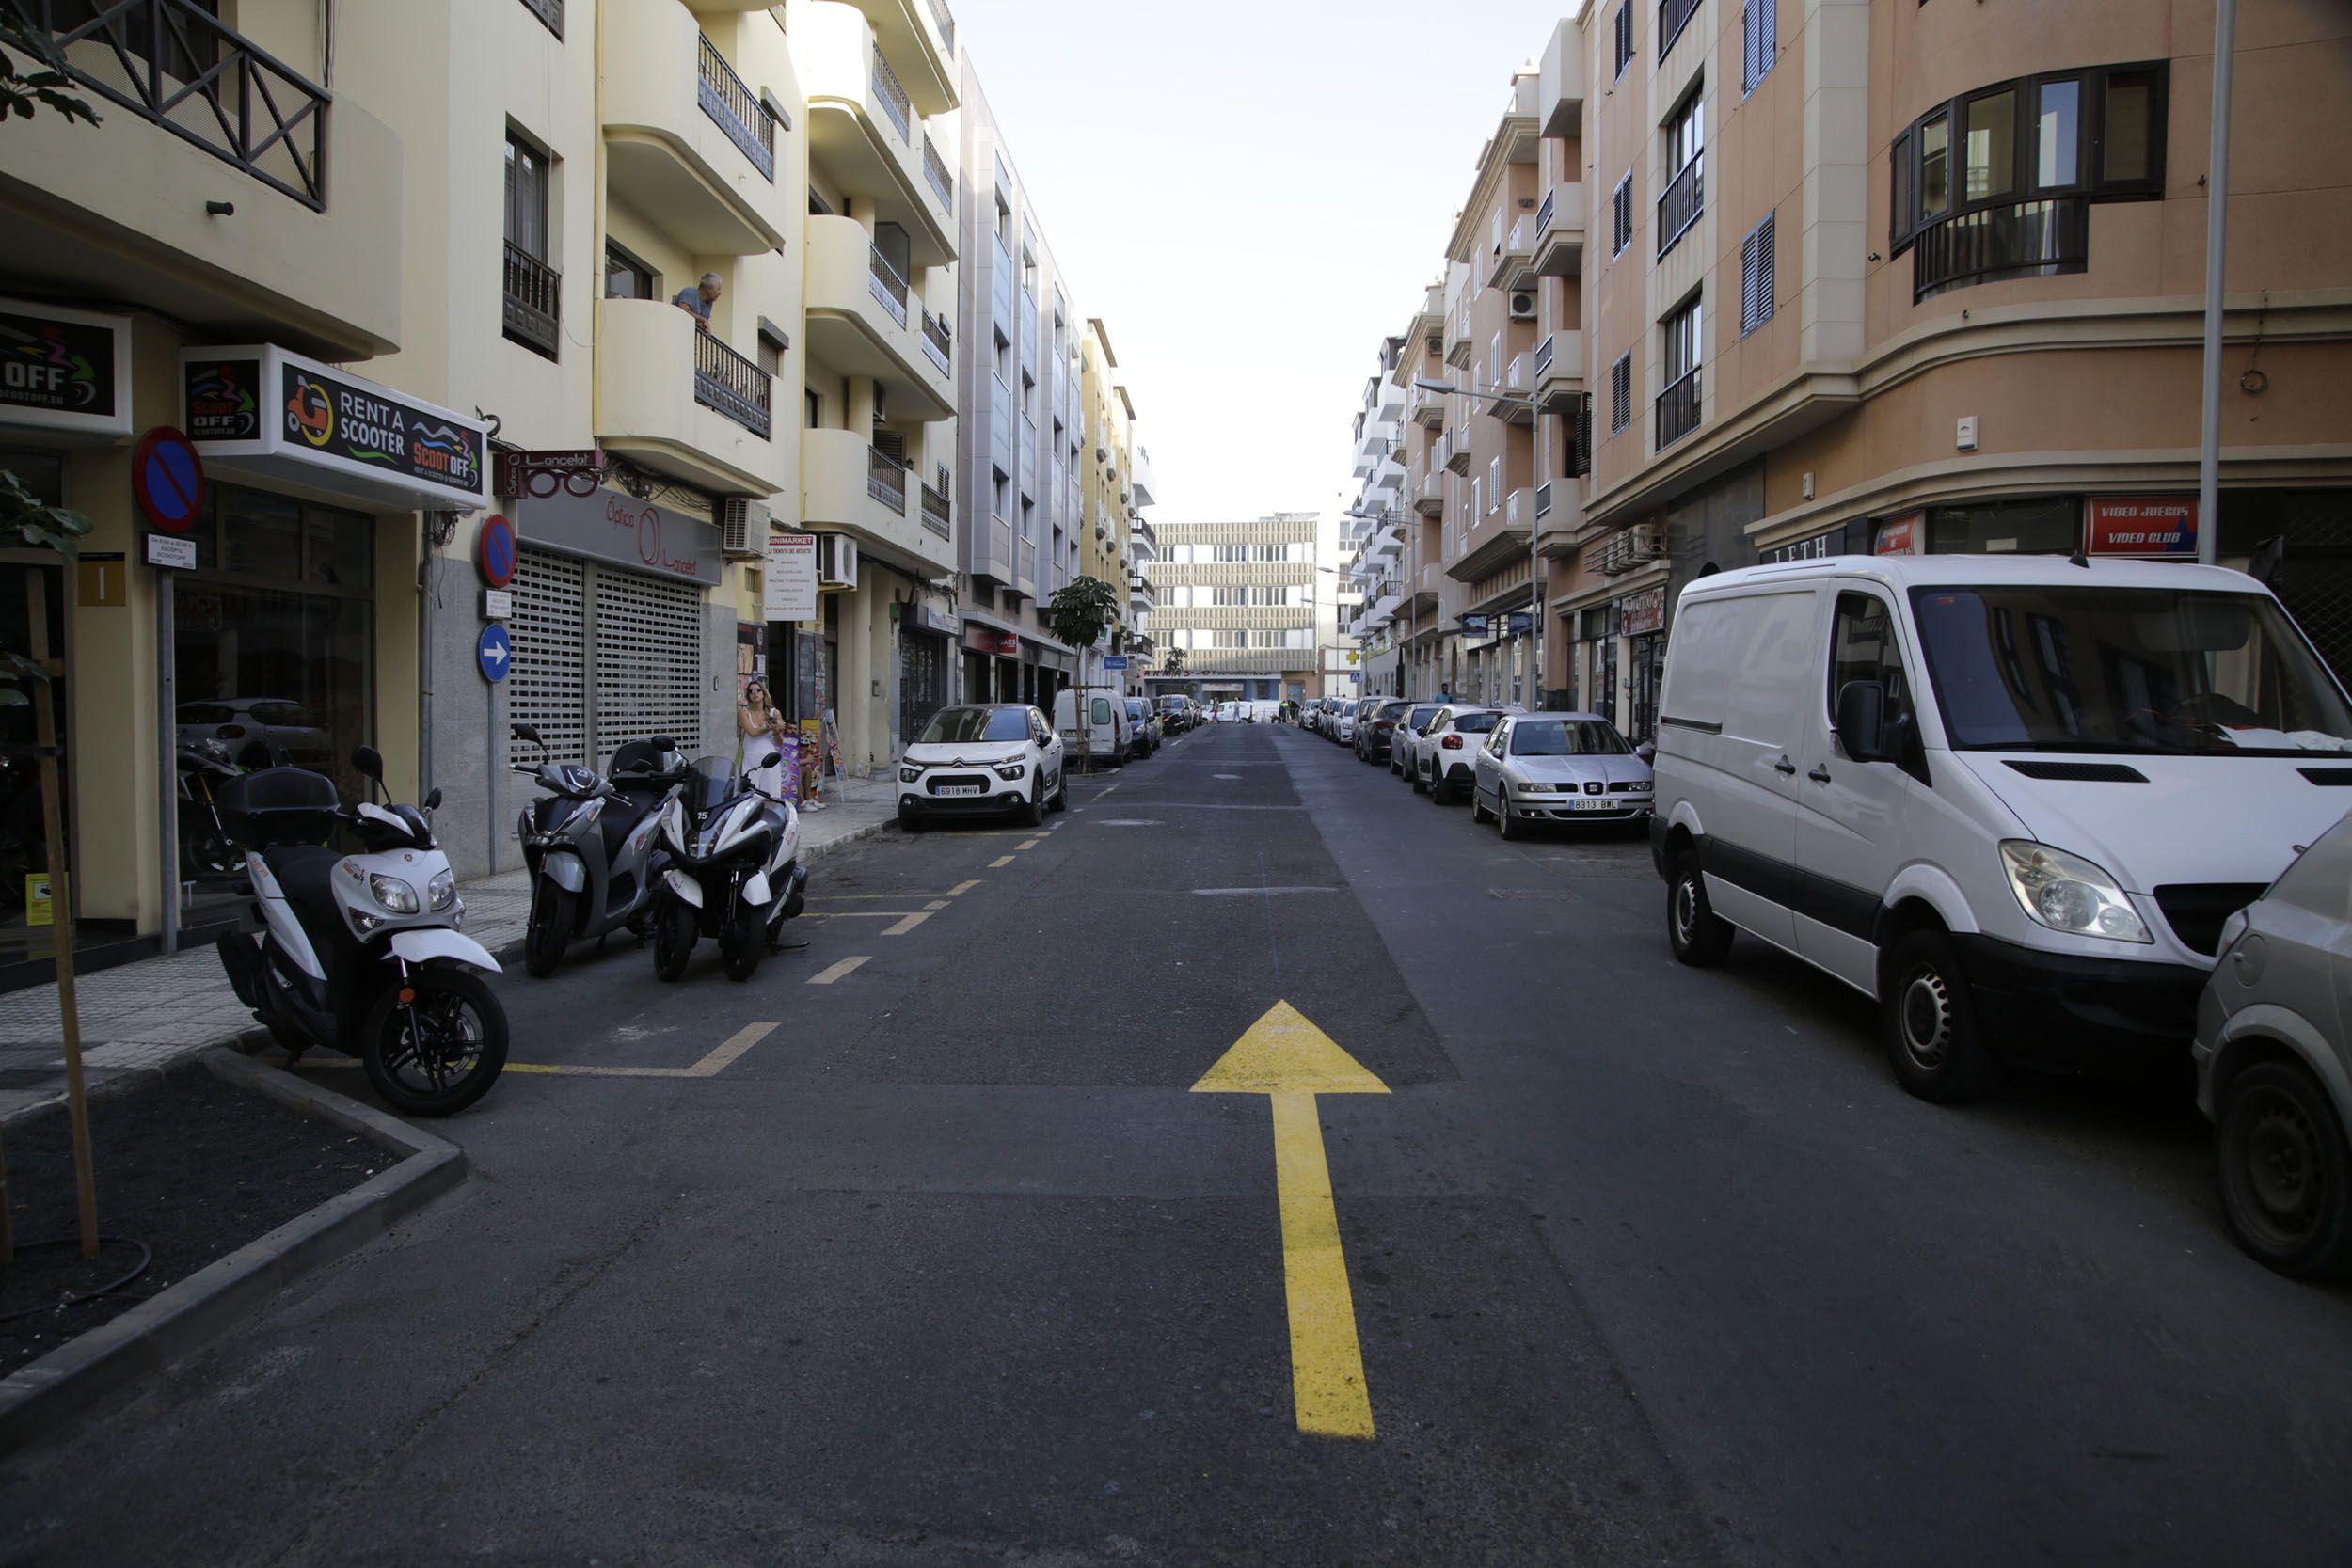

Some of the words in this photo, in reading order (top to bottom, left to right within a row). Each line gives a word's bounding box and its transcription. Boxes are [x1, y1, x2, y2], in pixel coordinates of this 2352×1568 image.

[4, 361, 65, 392] OFF
[340, 390, 389, 426] RENT
[391, 410, 405, 432] A
[194, 415, 234, 427] OFF
[341, 417, 405, 456] SCOOTER
[413, 441, 450, 472] SCOOT
[450, 456, 469, 478] OFF
[526, 453, 589, 466] Lancelot
[2101, 506, 2137, 517] VIDEO
[2140, 506, 2189, 517] JUEGOS
[2108, 532, 2145, 543] VIDEO
[2147, 532, 2181, 543] CLUB
[941, 786, 961, 796] 6918
[1575, 800, 1597, 809] 8313
[697, 811, 708, 820] 15
